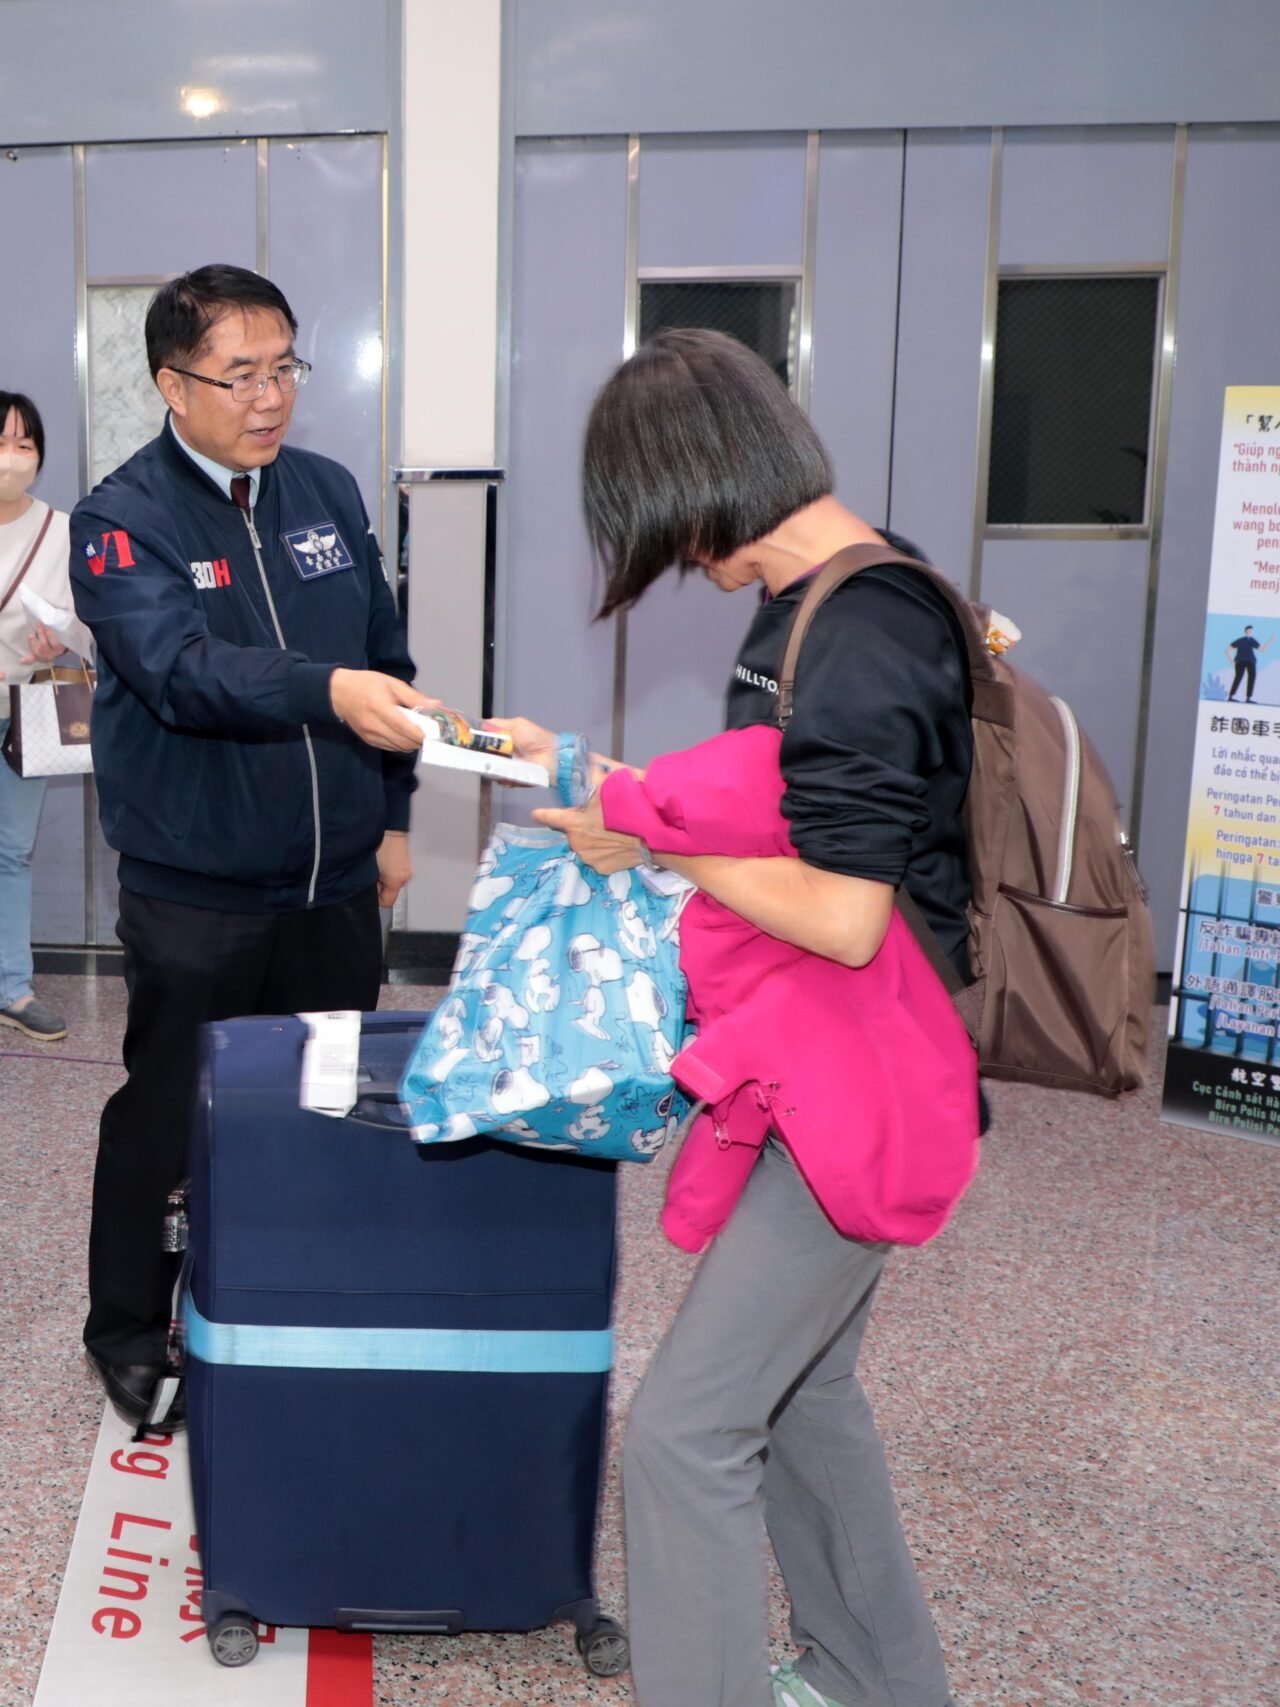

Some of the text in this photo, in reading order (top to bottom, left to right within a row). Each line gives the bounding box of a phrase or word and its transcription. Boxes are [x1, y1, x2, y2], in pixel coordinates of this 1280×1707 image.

[1233, 519, 1265, 534] wang
[736, 663, 780, 695] HILLTO
[1207, 787, 1263, 805] Peringatan
[1213, 804, 1276, 823] 7 tahun dan
[1216, 847, 1253, 865] hingga
[1257, 852, 1265, 865] 7
[1215, 1098, 1236, 1113] Biro
[1240, 1104, 1266, 1119] Polis
[1208, 1110, 1230, 1125] Biro
[1234, 1116, 1263, 1131] Polisi
[92, 1512, 172, 1639] Line
